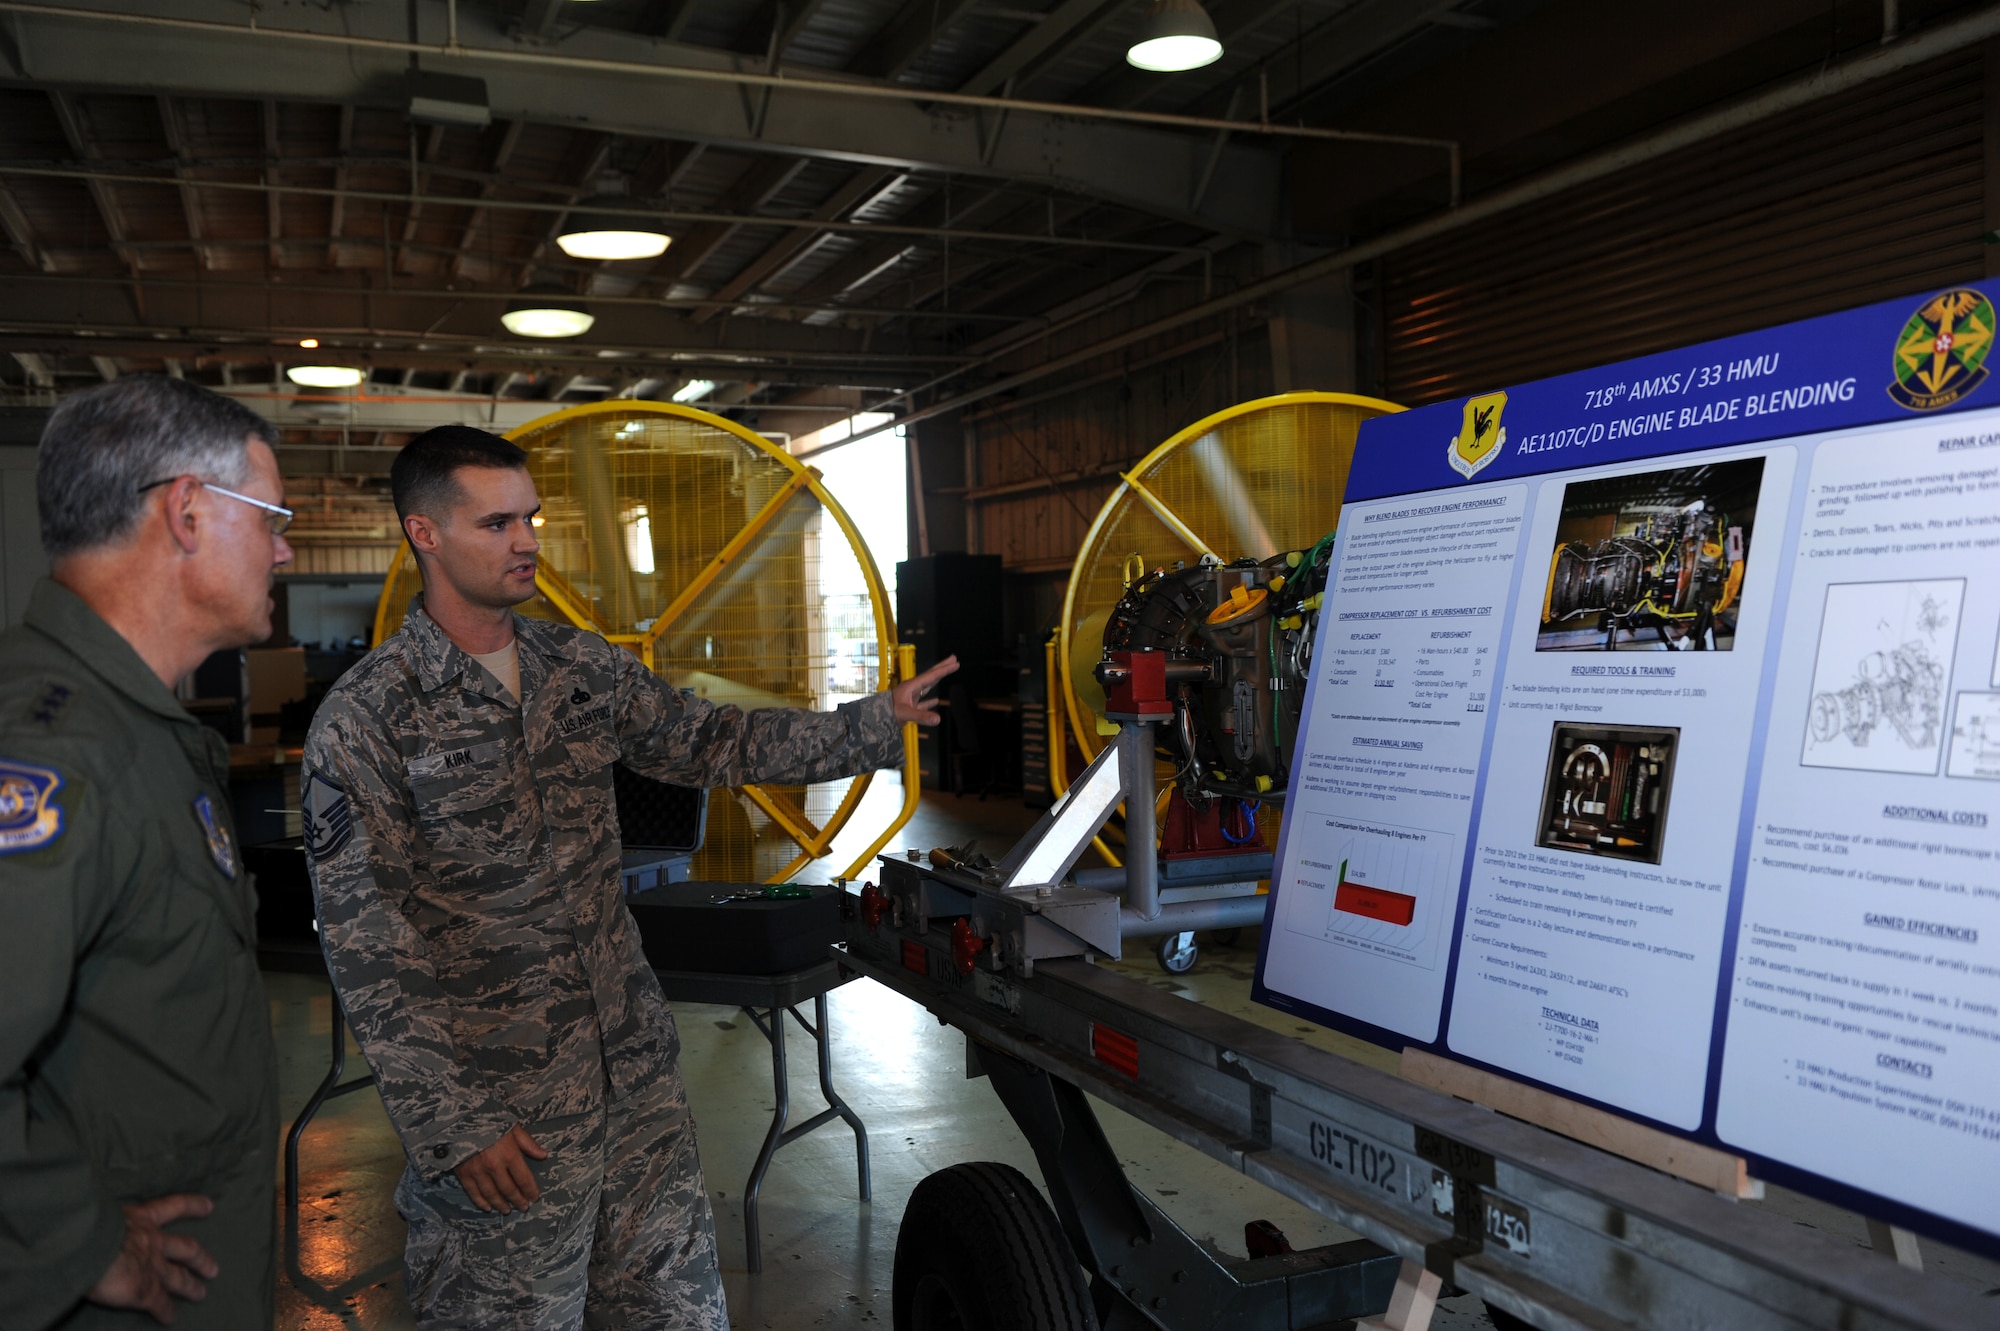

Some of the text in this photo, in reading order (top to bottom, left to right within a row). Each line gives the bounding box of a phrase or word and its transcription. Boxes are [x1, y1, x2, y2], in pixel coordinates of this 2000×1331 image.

[1585, 353, 1779, 411] 718th AMXS / 33 HMU
[1516, 377, 1856, 456] AE1107C/D ENGINE BLADE BLENDING
[1821, 468, 1999, 493] This procedure involves removing damaged
[1364, 515, 1376, 523] WHY
[1375, 512, 1391, 521] BLEND
[1391, 510, 1410, 519] BLADES
[1417, 505, 1441, 516] RECOVER
[1441, 503, 1462, 513] ENGINE
[1461, 496, 1507, 510] PERFORMANCE?
[1339, 612, 1370, 621] COMPRESSOR
[1369, 610, 1404, 619] REPLACEMENT
[1404, 610, 1418, 618] COST
[1431, 607, 1477, 617] REFURBISHMENT
[1477, 606, 1492, 615] COST
[1430, 631, 1472, 639] REFURBISHMENT
[1571, 666, 1606, 675] REQUIRED
[1606, 666, 1630, 675] TOOLS
[1640, 666, 1676, 676] TRAINING
[1433, 691, 1449, 700] Engine
[1440, 680, 1454, 688] Check
[1454, 680, 1468, 689] Flight
[1537, 686, 1560, 694] blending
[1682, 688, 1707, 697] $3,000)
[1559, 703, 1574, 712] Rigid
[1574, 703, 1603, 712] Borescope
[560, 705, 611, 733] U.S. AIR FORCE
[1352, 737, 1423, 750] ESTIMATED ANNUAL SAVINGS
[443, 750, 474, 769] KIRK
[1883, 805, 1987, 826] ADDITIONAL COSTS
[1334, 821, 1358, 830] Comparison
[1366, 826, 1391, 837] Overhauling
[1395, 831, 1412, 839] Engines
[1483, 857, 1507, 868] currently
[1528, 865, 1585, 880] instructors/certifiers
[1498, 876, 1509, 885] Two
[1509, 880, 1527, 888] engine
[1527, 882, 1545, 892] troops
[1546, 885, 1559, 894] have
[1561, 889, 1583, 900] already
[1584, 893, 1599, 901] been
[1600, 895, 1614, 906] fully
[1615, 899, 1638, 909] trained
[1645, 905, 1674, 916] certified
[1474, 918, 1501, 929] evaluation
[1864, 912, 1978, 942] GAINED EFFICIENCIES
[1471, 933, 1548, 958] Current Course Requirements:
[1486, 956, 1510, 967] Minimum
[1515, 963, 1529, 972] level
[1542, 1006, 1599, 1030] TECHNICAL DATA
[1876, 1053, 1933, 1078] CONTACTS
[1310, 1121, 1396, 1194] GET02
[1486, 1205, 1528, 1246] 1250
